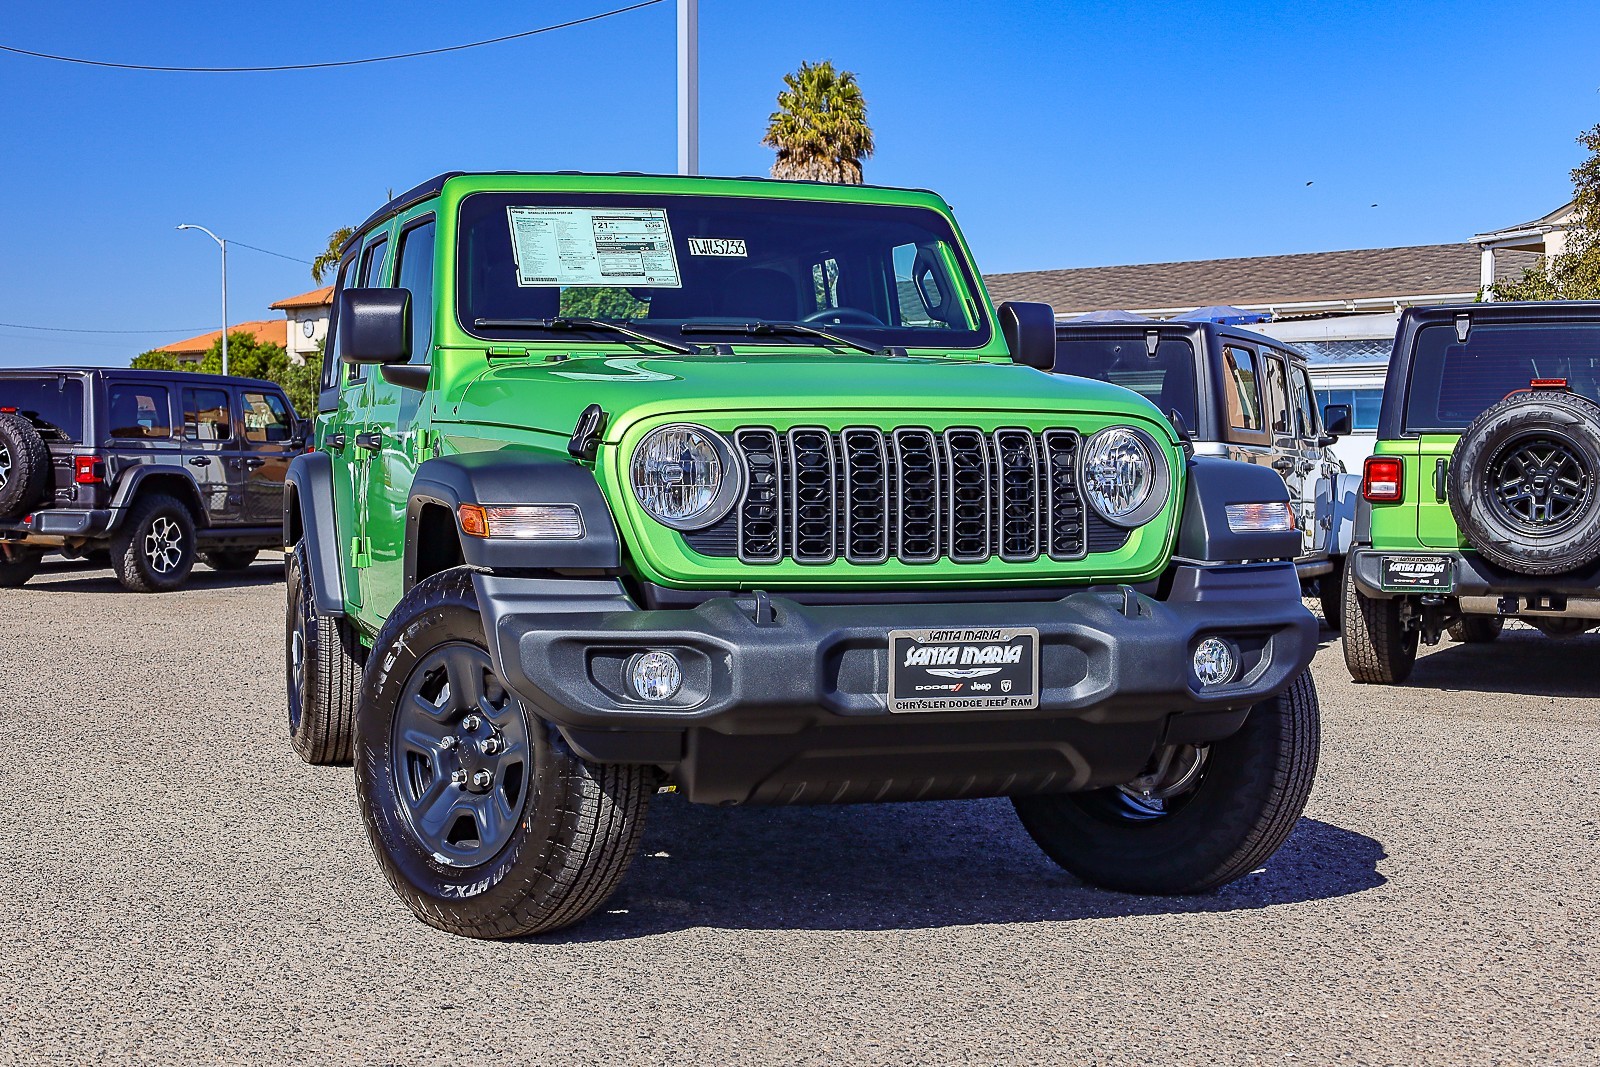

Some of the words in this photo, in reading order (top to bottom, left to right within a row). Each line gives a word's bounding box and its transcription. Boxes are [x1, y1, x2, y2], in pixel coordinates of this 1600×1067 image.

[1389, 563, 1415, 572] SANTA
[1415, 563, 1446, 573] MARIA
[927, 630, 961, 642] SANTA
[963, 629, 1001, 641] MARIA
[903, 645, 960, 668] SANTA
[960, 644, 1024, 665] MARIA
[970, 682, 992, 692] Jeep
[895, 700, 948, 710] CHRYSLER
[949, 699, 983, 708] DODGE
[985, 698, 1008, 707] JEEP
[1010, 698, 1032, 706] RAM
